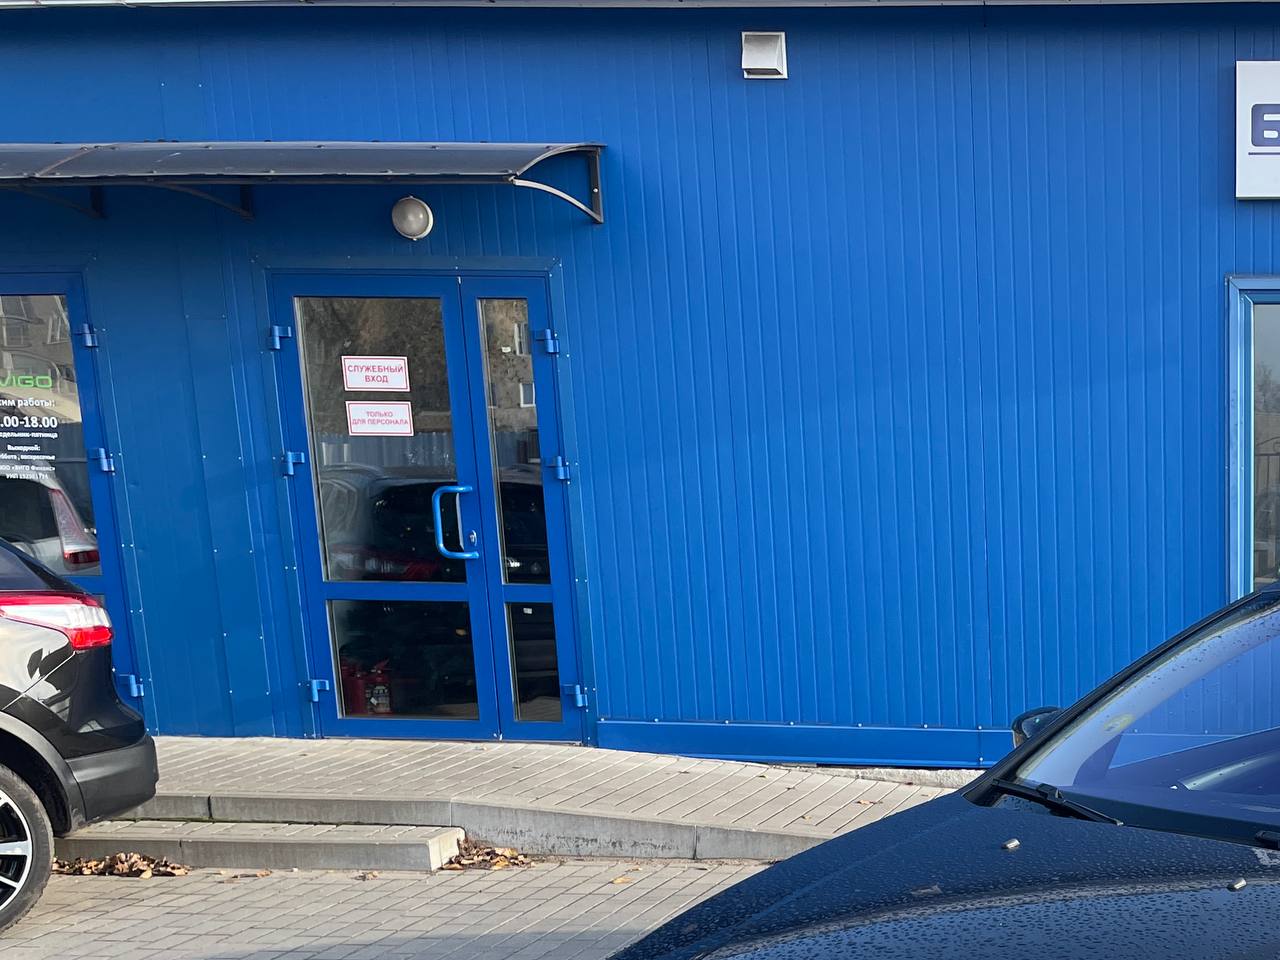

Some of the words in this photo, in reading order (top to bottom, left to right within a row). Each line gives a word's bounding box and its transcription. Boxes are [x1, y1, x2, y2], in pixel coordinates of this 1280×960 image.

[347, 364, 404, 373] СЛУЖЕБНЫЙ
[364, 375, 389, 383] ВХОД
[17, 397, 55, 408] работы:
